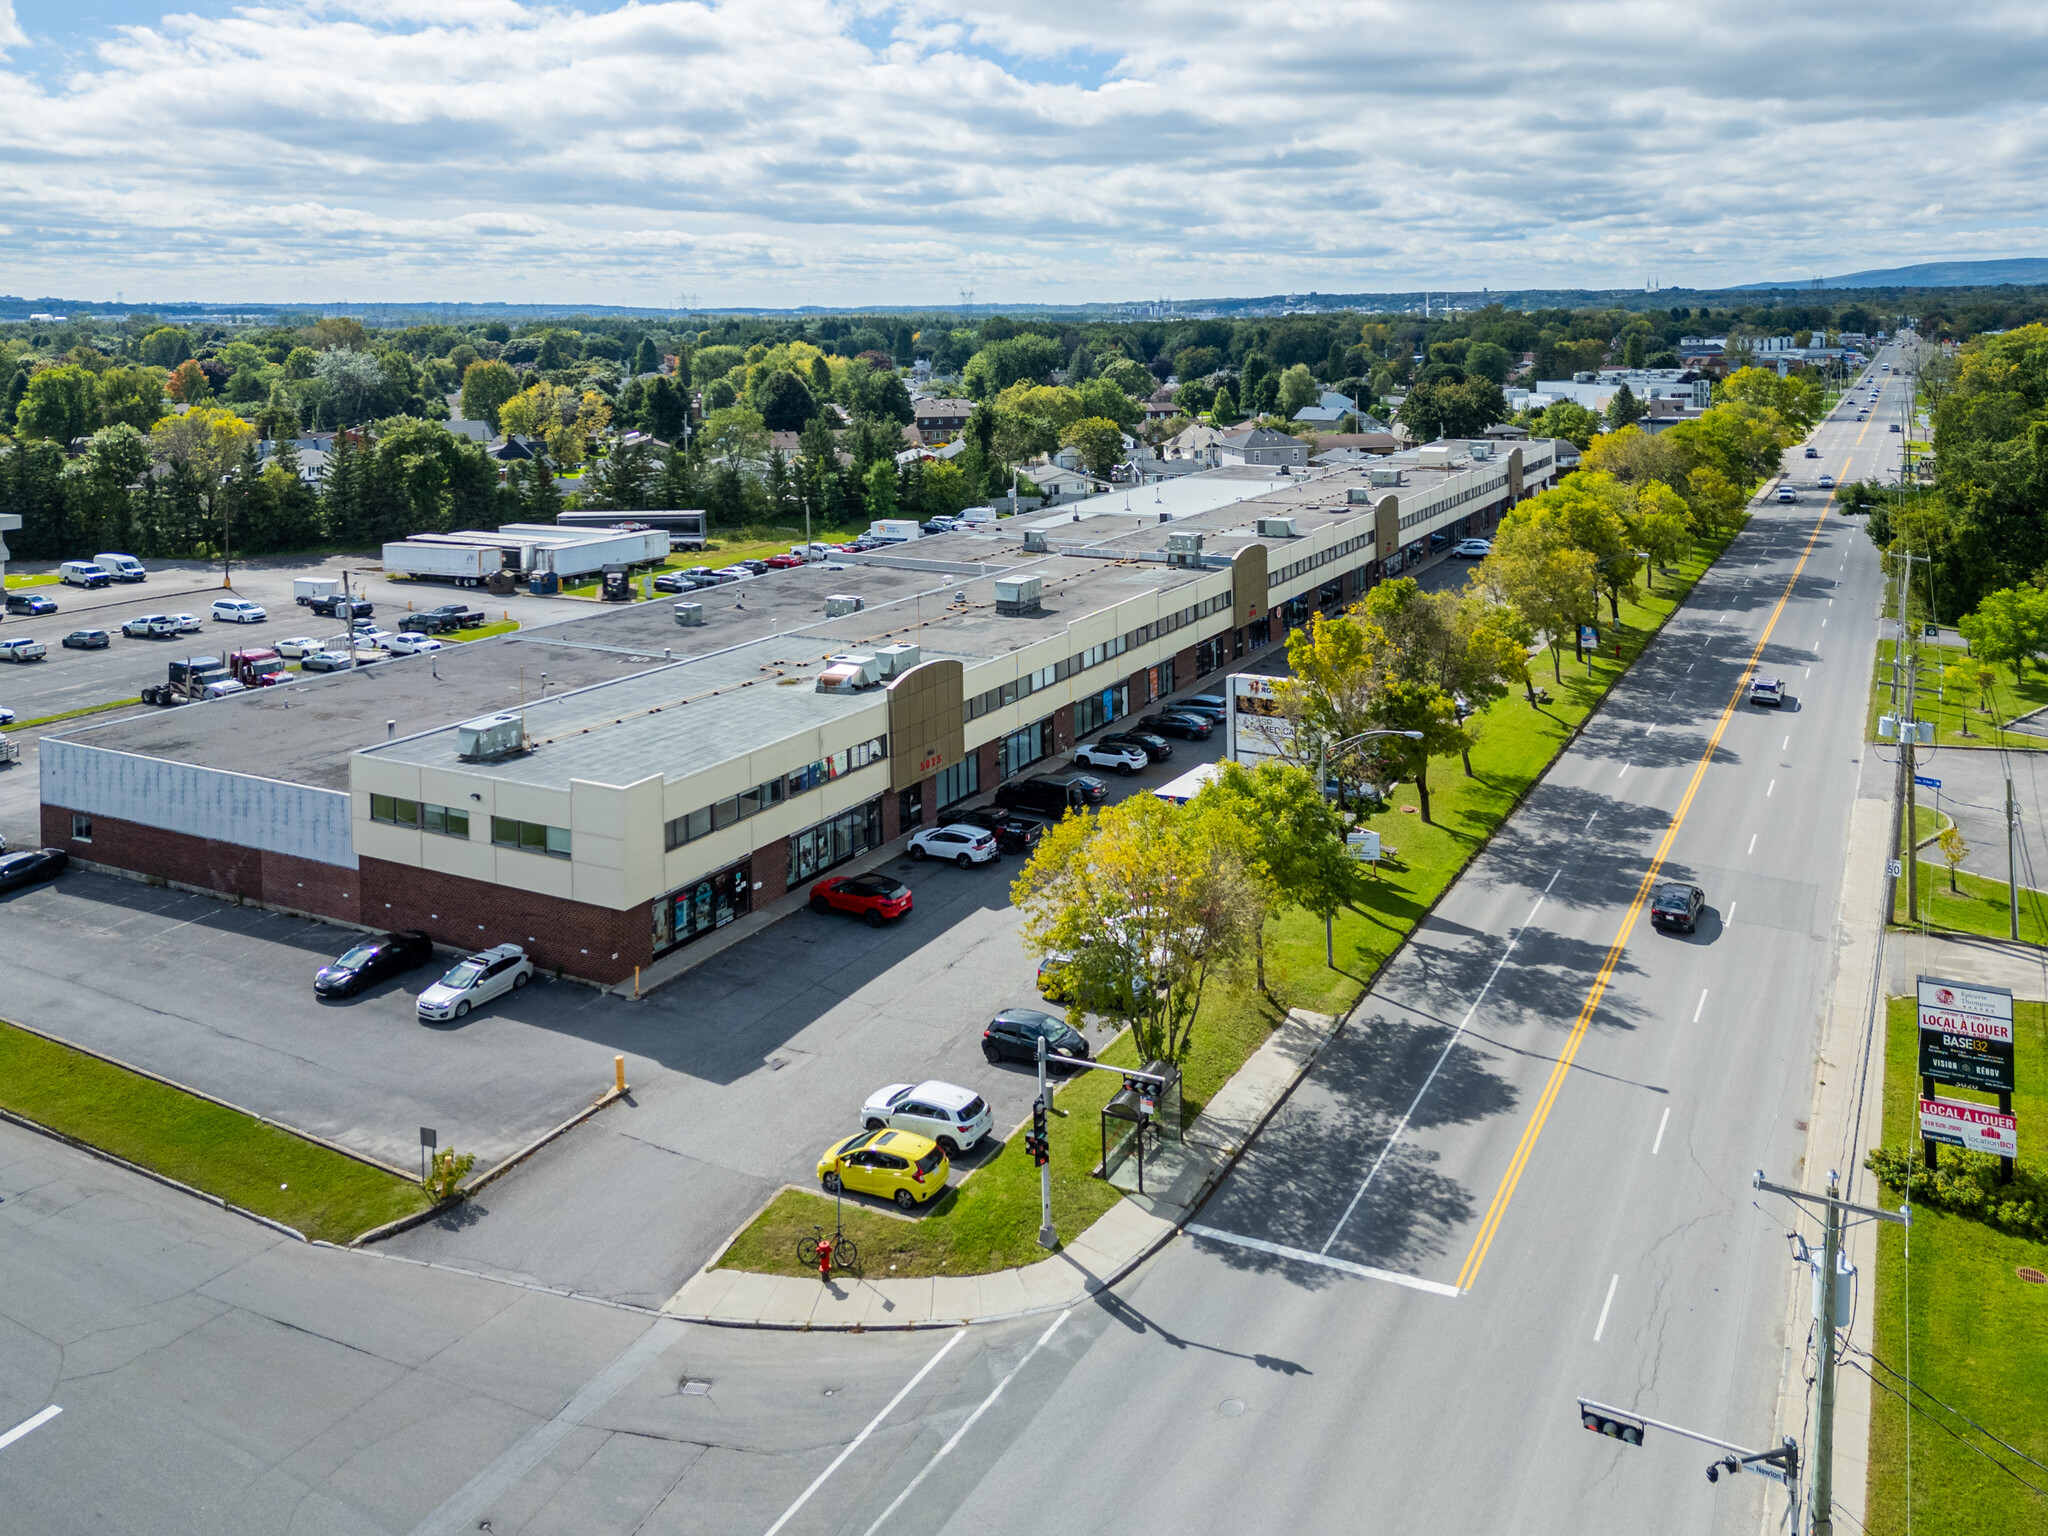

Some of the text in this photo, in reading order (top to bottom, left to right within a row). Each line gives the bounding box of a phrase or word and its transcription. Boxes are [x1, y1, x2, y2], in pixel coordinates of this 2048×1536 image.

[1923, 1014, 2008, 1038] LOCAL À LOUER
[1943, 1035, 1988, 1052] BASE132
[1933, 1058, 1958, 1070] VISION
[1923, 1103, 2014, 1129] LOCAL À LOUER
[1967, 1135, 2014, 1149] locationBCI
[1756, 1465, 1782, 1480] Newton
